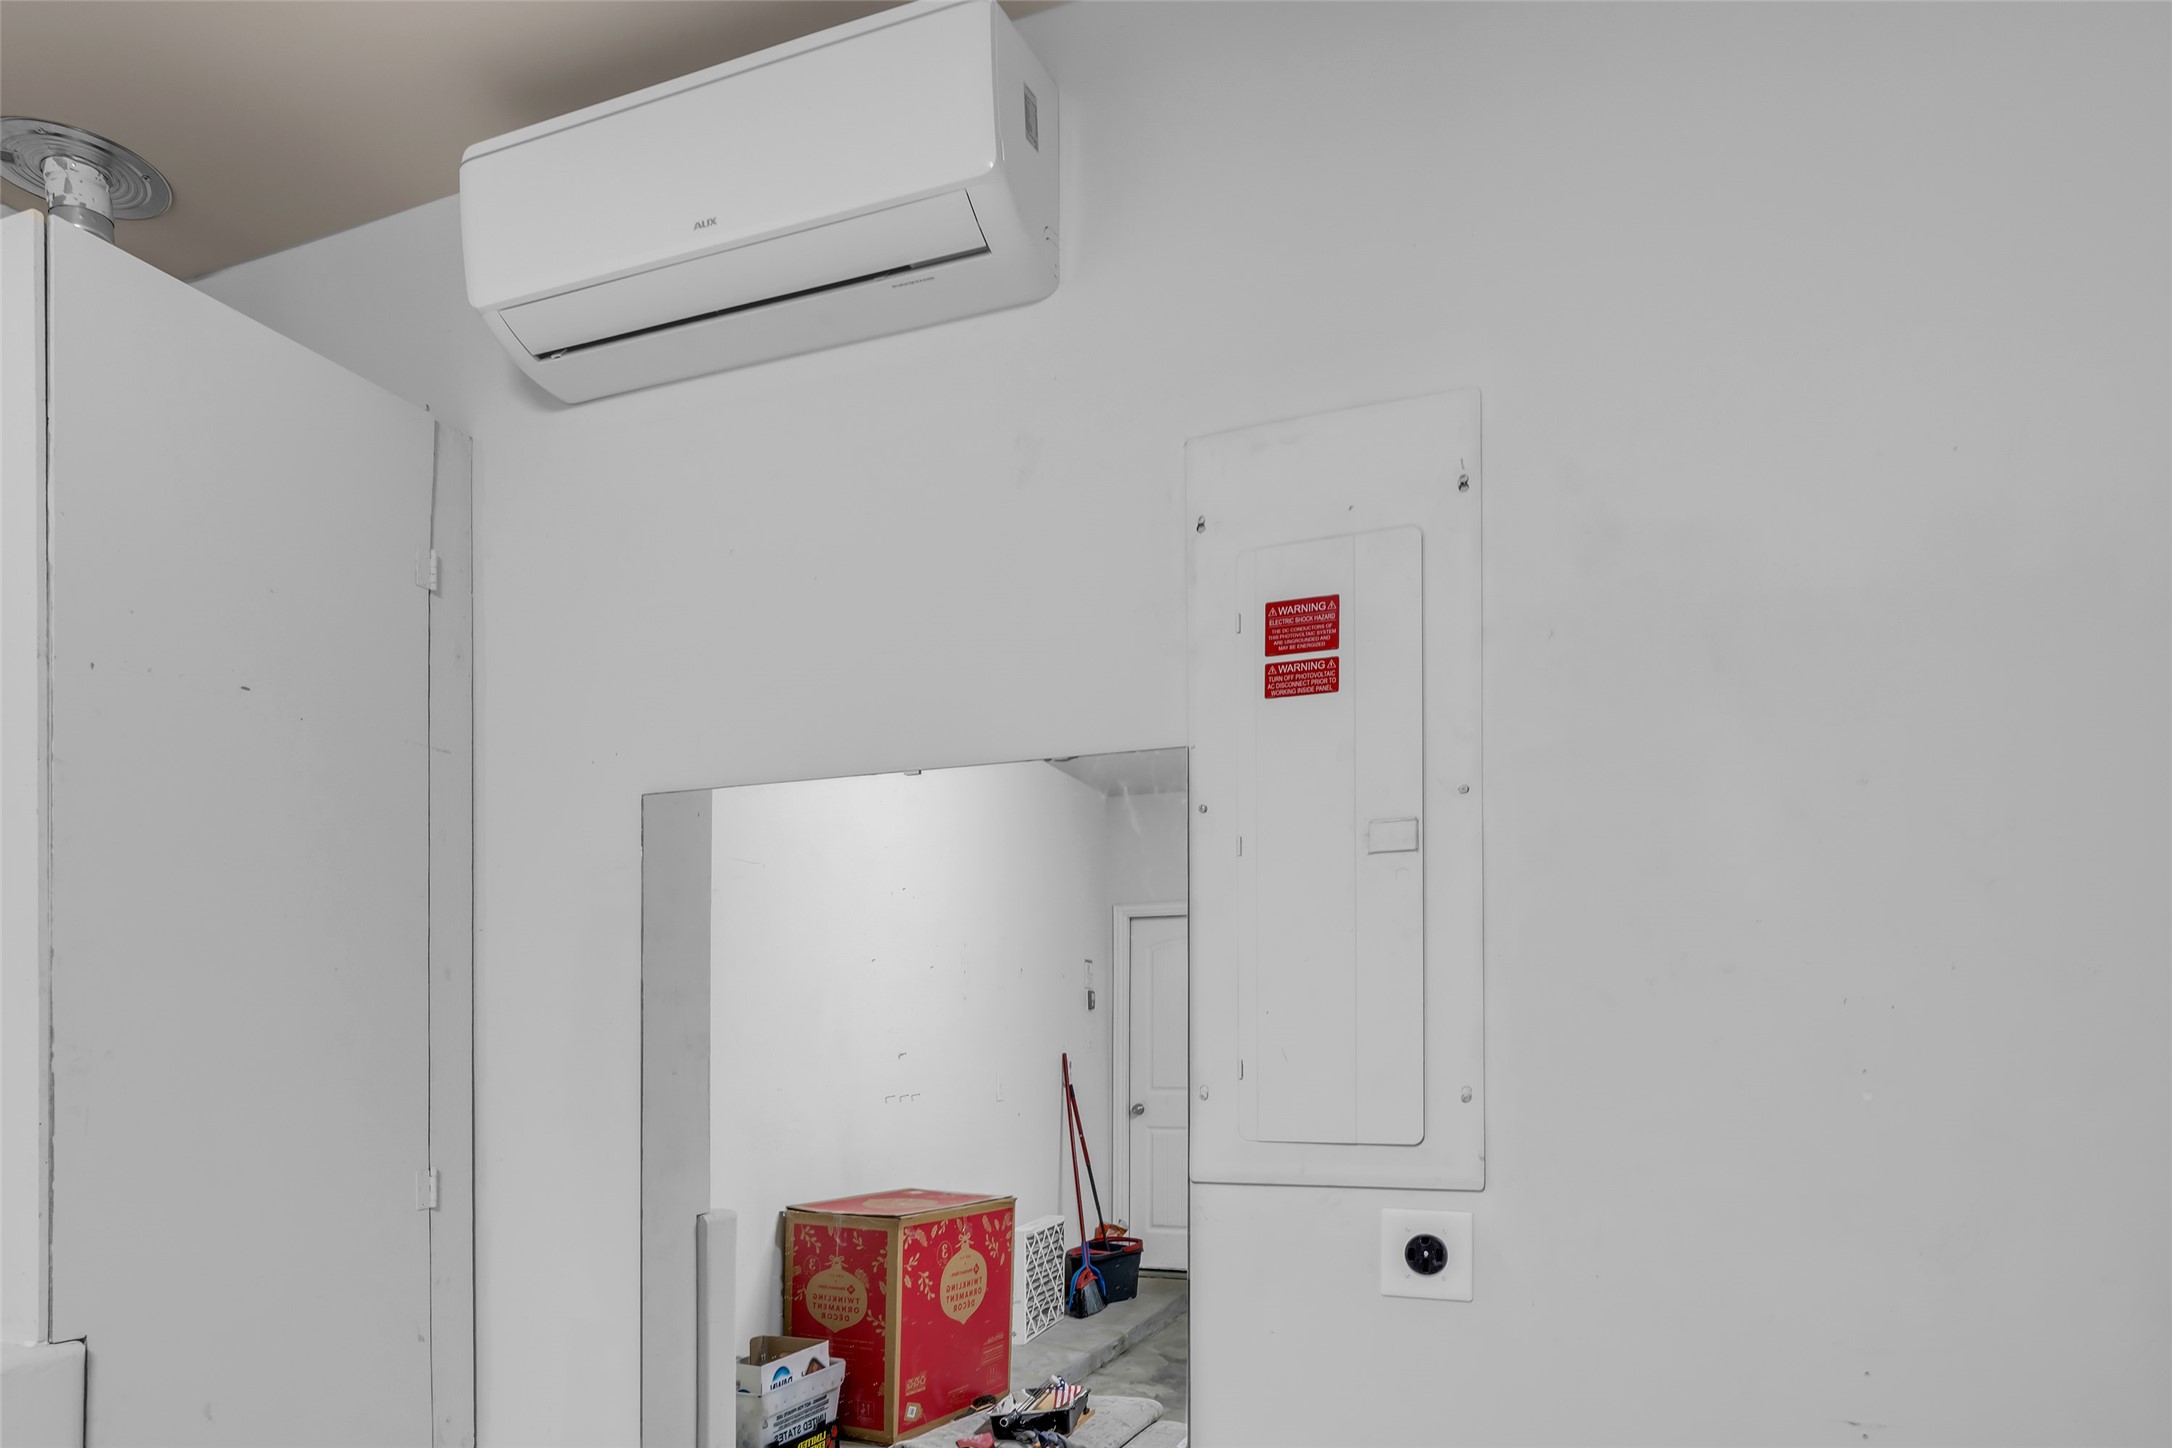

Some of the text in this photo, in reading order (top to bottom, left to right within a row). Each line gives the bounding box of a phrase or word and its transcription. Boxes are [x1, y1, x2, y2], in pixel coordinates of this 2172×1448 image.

[694, 216, 718, 231] AUX
[1278, 602, 1326, 616] WARNING
[1269, 613, 1336, 626] ELECTRIC SHOCK HAZARD
[1290, 624, 1325, 632] CONDUCTORS
[1280, 630, 1315, 640] PHOTOVOLTAIC
[1316, 628, 1337, 636] SYSTEM
[1284, 636, 1320, 645] UNGROUNDED
[1278, 660, 1326, 674] WARNING
[1295, 670, 1336, 680] PHOTOVOLTAIC
[1276, 679, 1310, 689] DISCONNECT
[1270, 688, 1296, 697] WORKING
[1297, 686, 1315, 694] INSIDE
